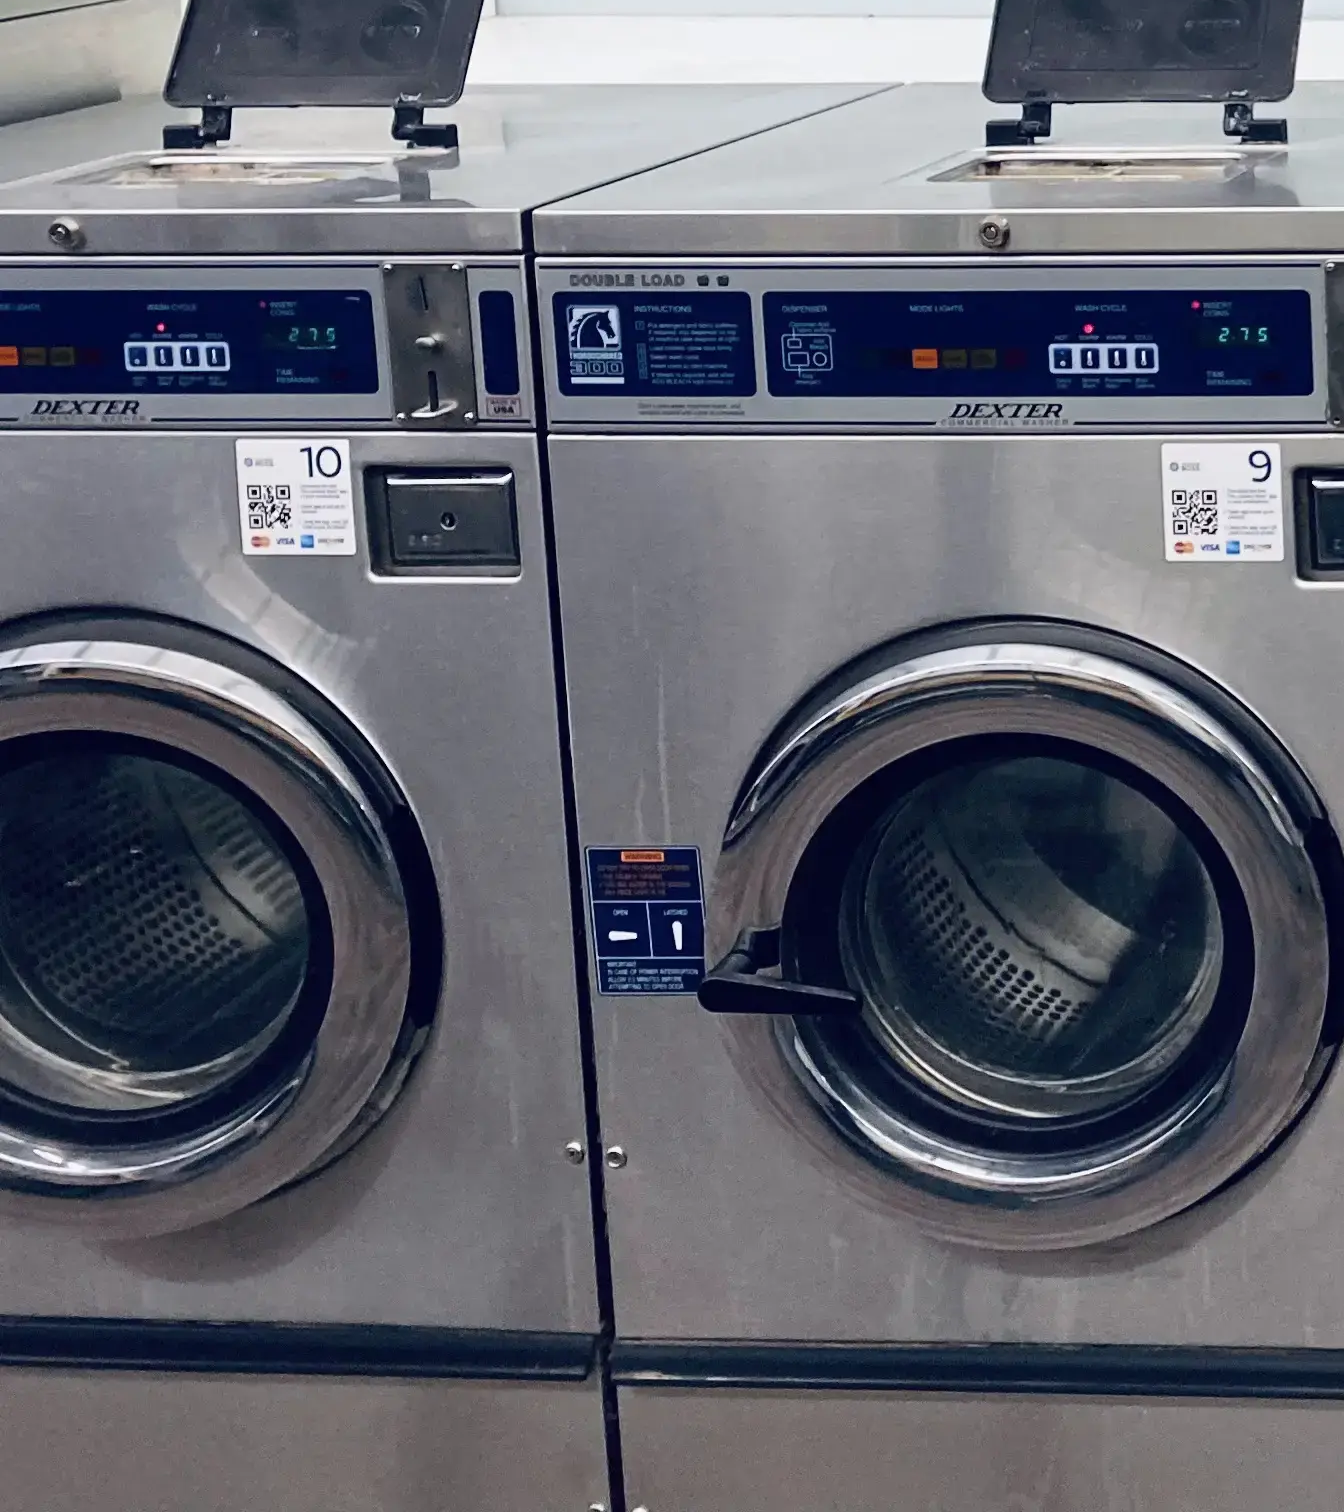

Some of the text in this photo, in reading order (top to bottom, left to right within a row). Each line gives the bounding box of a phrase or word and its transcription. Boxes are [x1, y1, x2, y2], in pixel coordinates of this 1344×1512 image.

[569, 274, 686, 287] DOUBLE LOAD
[30, 399, 141, 416] DEXTER
[948, 403, 1064, 419] DEXTER
[299, 445, 342, 479] 10
[1248, 449, 1273, 483] 9
[1200, 543, 1221, 552] VISA
